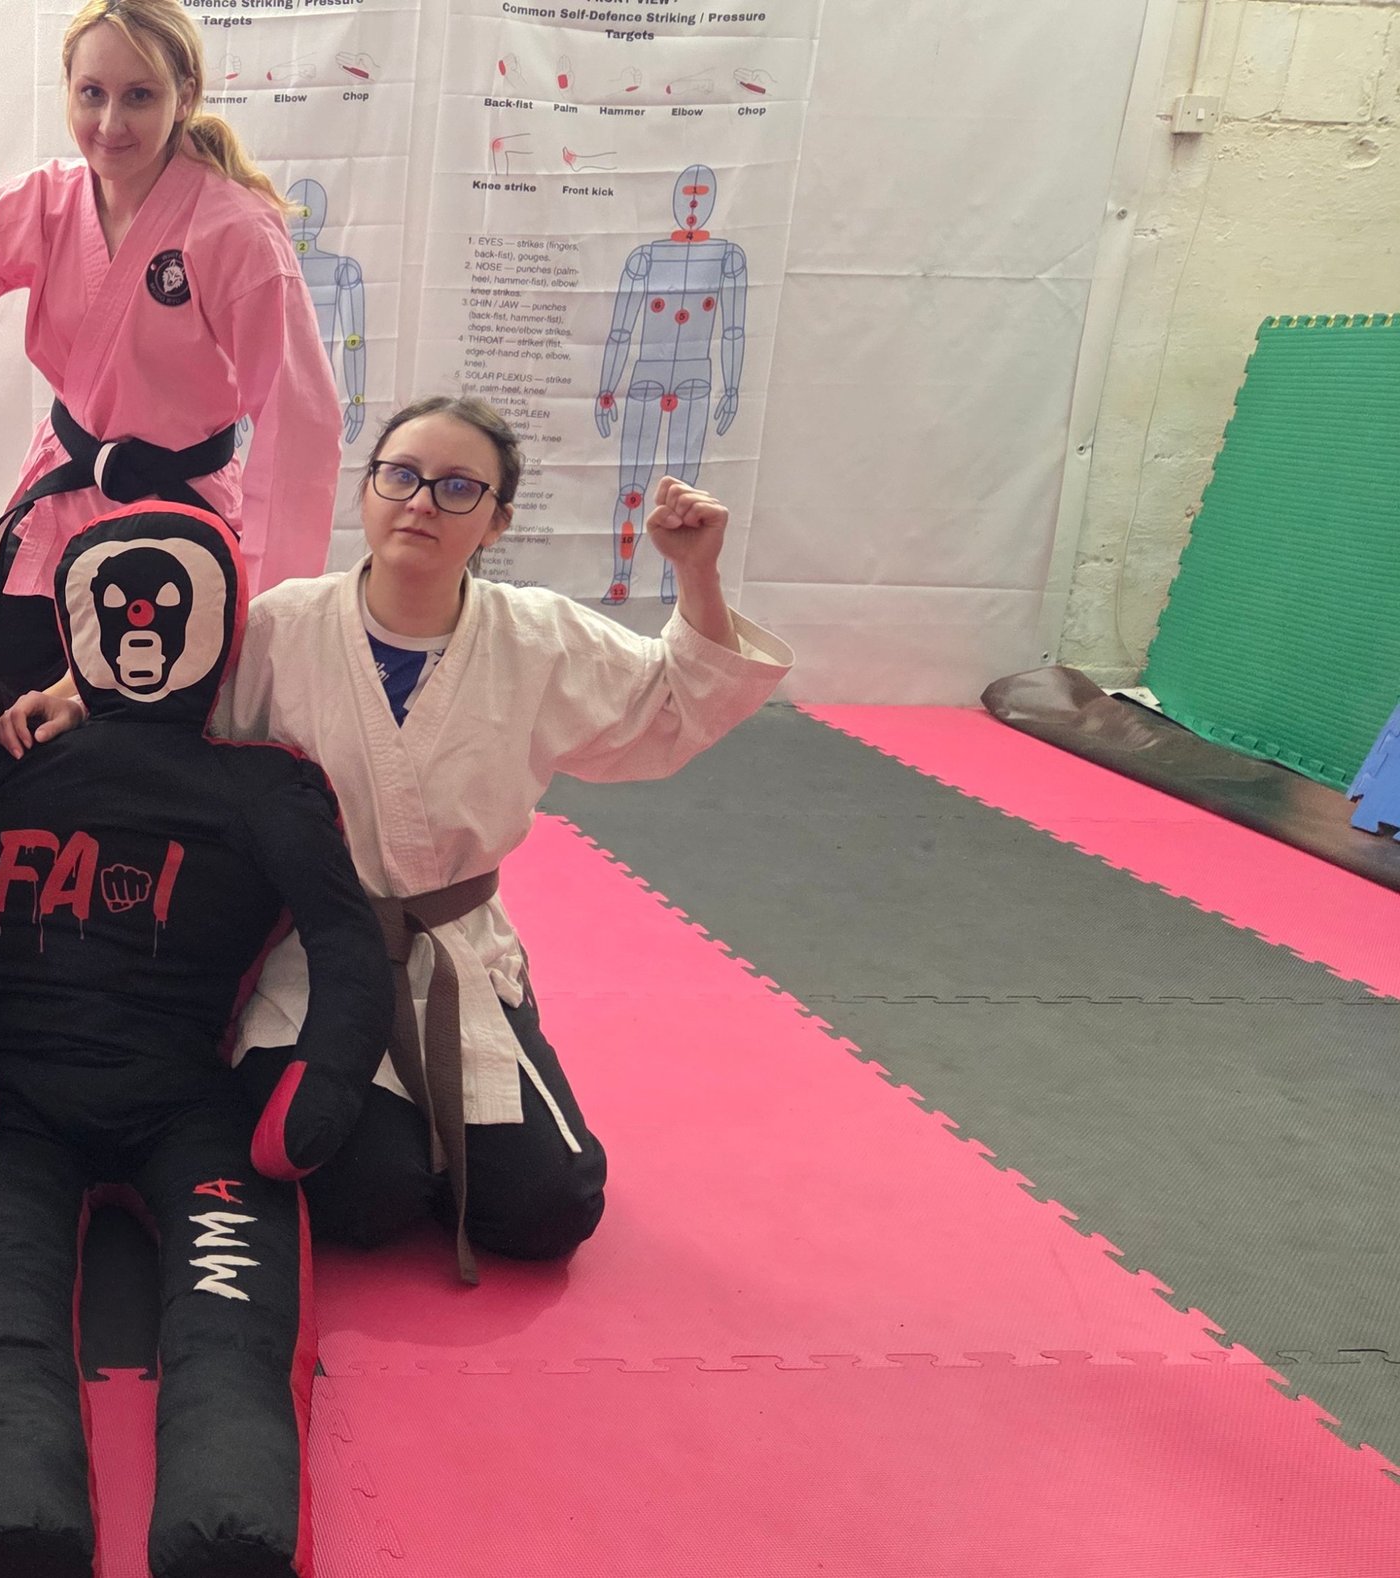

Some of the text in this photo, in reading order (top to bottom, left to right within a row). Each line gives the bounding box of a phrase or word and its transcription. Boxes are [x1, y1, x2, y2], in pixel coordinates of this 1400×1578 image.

[502, 2, 766, 25] Common Self-Defence Striking / Pressure
[202, 15, 252, 28] Targets
[604, 29, 655, 42] Targets
[274, 94, 308, 103] Elbow
[342, 92, 370, 102] Chop
[484, 98, 534, 110] Back-fist
[553, 104, 578, 114] Palm
[599, 106, 646, 117] Hammer
[671, 107, 704, 117] Elbow
[737, 106, 767, 117] Chop
[472, 180, 537, 193] Knee strike
[562, 185, 614, 197] Front kick
[478, 237, 504, 247] EYES
[516, 240, 544, 249] strikes
[475, 262, 502, 272] NOSE
[516, 265, 551, 276] punches
[470, 286, 491, 295] knee
[469, 298, 493, 308] CHIN
[499, 300, 519, 309] JAW
[532, 303, 567, 314] punches
[468, 335, 505, 345] THROAT
[517, 339, 544, 348] strikes
[465, 347, 520, 358] edge-of-hand
[465, 370, 495, 381] SOLAR
[496, 371, 533, 382] PLEXUS
[545, 376, 572, 384] strikes
[490, 396, 509, 405] front
[500, 408, 551, 419] ER-SPLEEN
[542, 434, 562, 443] knee
[620, 536, 634, 544] 10
[614, 588, 625, 596] 11
[188, 1178, 262, 1302] MMA
